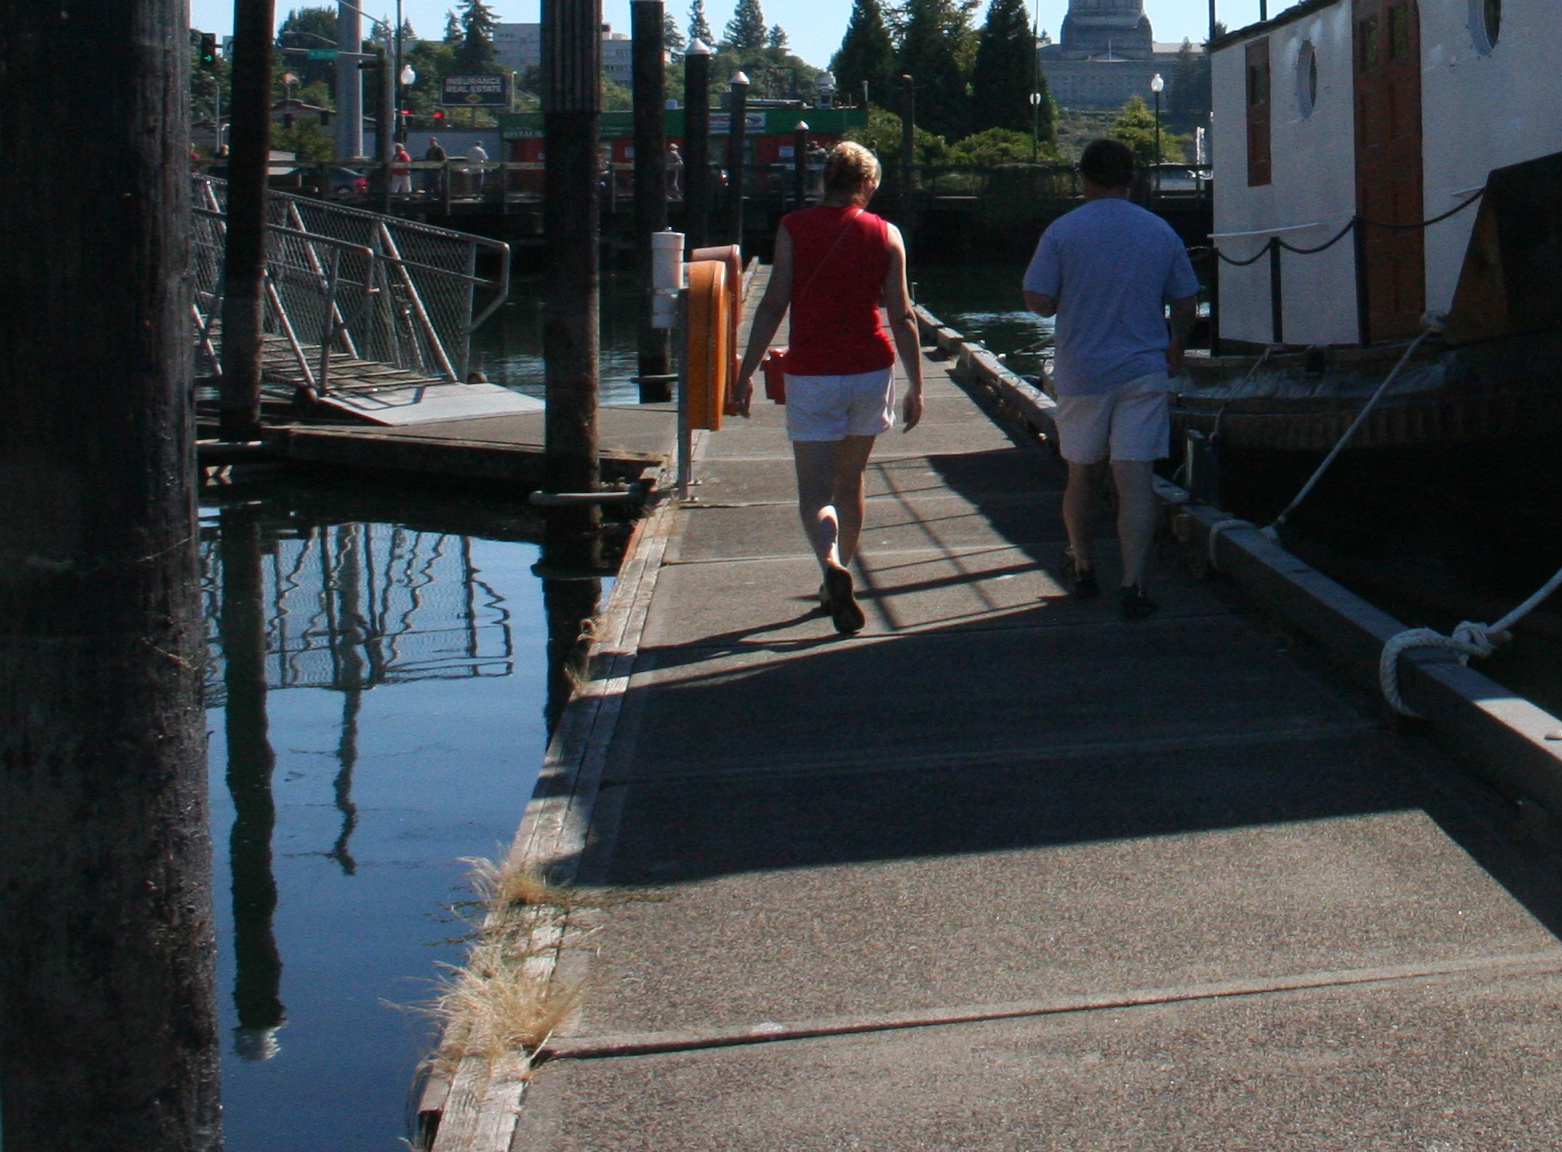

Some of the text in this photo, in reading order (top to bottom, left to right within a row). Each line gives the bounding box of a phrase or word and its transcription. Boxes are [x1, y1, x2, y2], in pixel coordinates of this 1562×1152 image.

[445, 77, 502, 85] INSURANCE
[445, 85, 502, 93] REAL ESTATE
